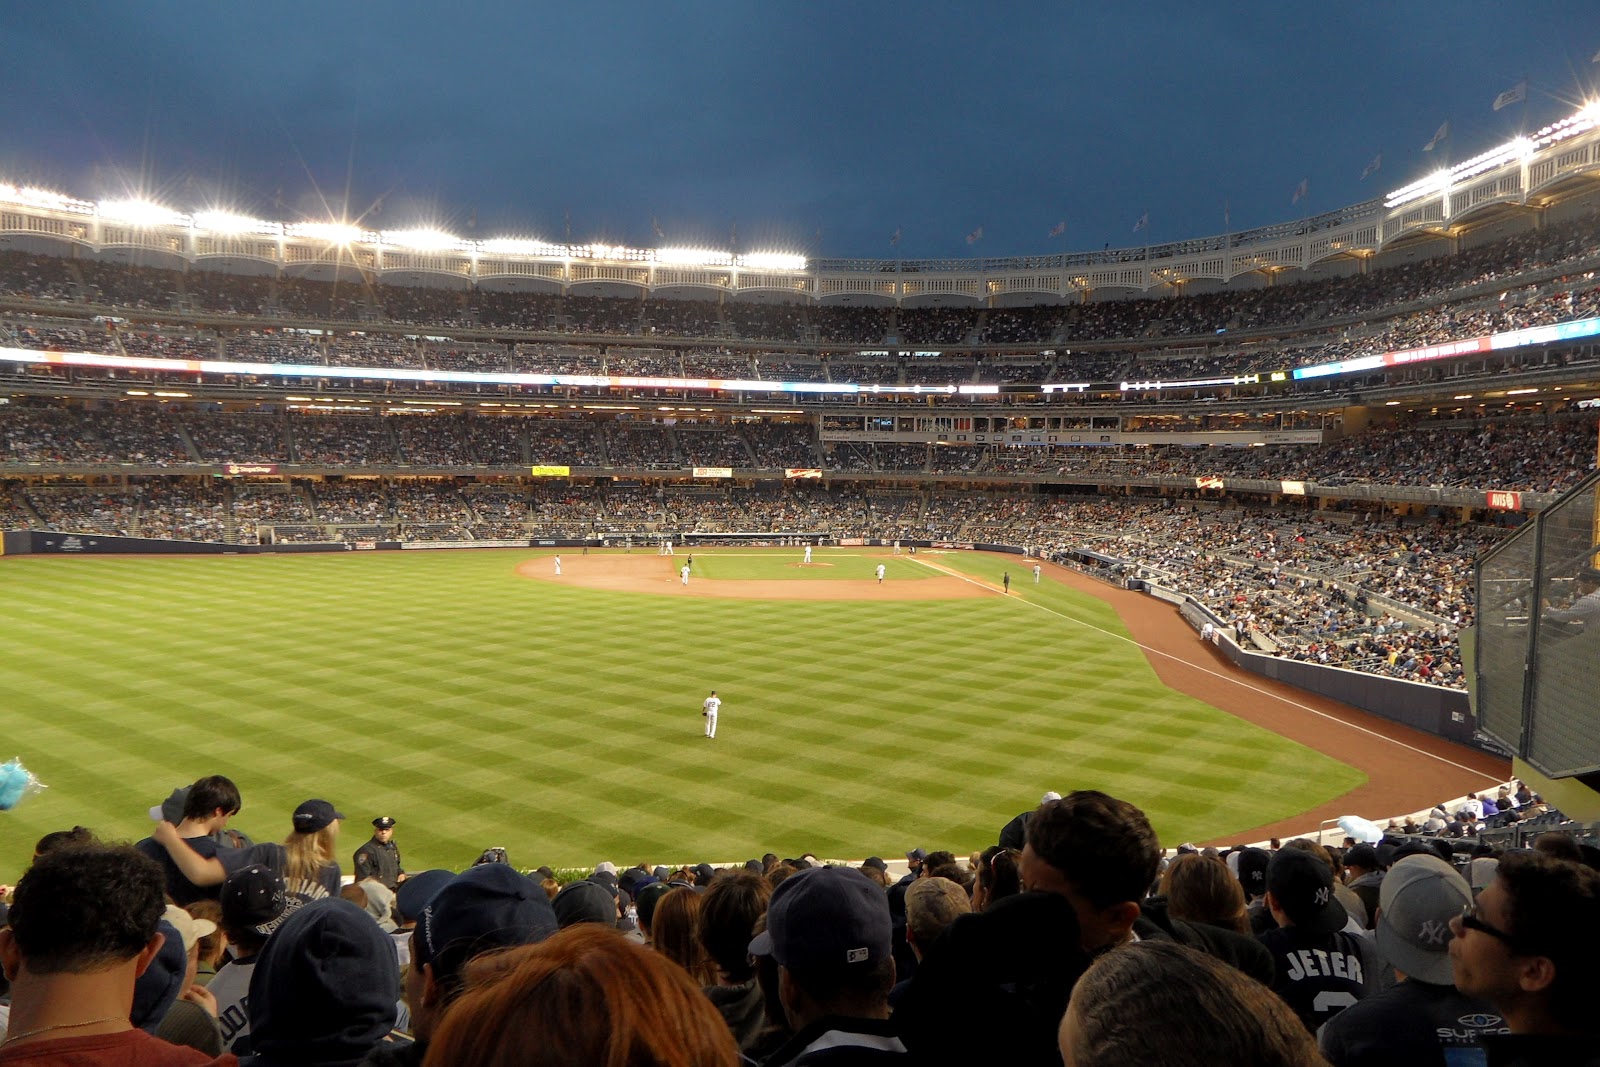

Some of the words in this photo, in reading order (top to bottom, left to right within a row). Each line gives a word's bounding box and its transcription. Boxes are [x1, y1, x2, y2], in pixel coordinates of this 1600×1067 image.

[1492, 493, 1507, 507] AVIS
[1472, 804, 1479, 812] 7
[1314, 886, 1330, 906] NY
[1418, 920, 1447, 945] NY
[1286, 948, 1364, 985] JETER
